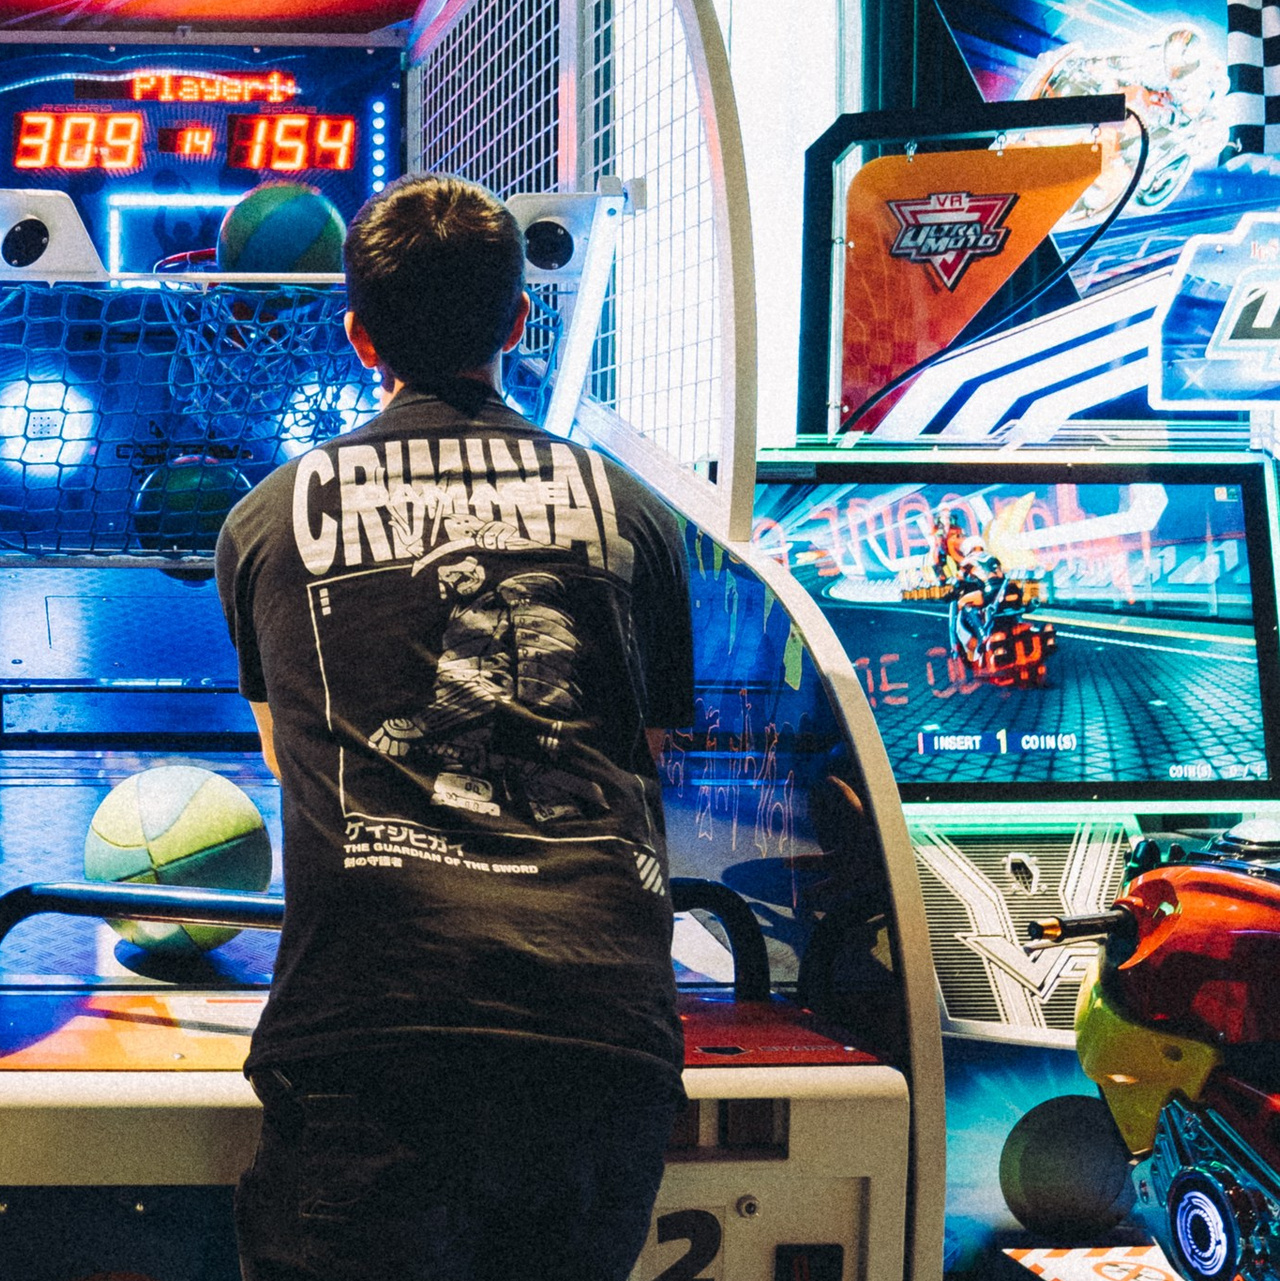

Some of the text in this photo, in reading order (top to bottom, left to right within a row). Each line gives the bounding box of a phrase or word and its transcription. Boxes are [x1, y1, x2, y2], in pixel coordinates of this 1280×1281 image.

[40, 103, 113, 113] RECORD
[259, 105, 318, 114] SCORE
[15, 116, 356, 170] 309 14 154
[936, 195, 963, 207] VR
[900, 223, 982, 248] ULTRA
[921, 233, 997, 254] MOTO
[933, 728, 1078, 755] INSERT 1 COIN(S)
[343, 843, 539, 874] THE GUARDIAN OF THE SWORD
